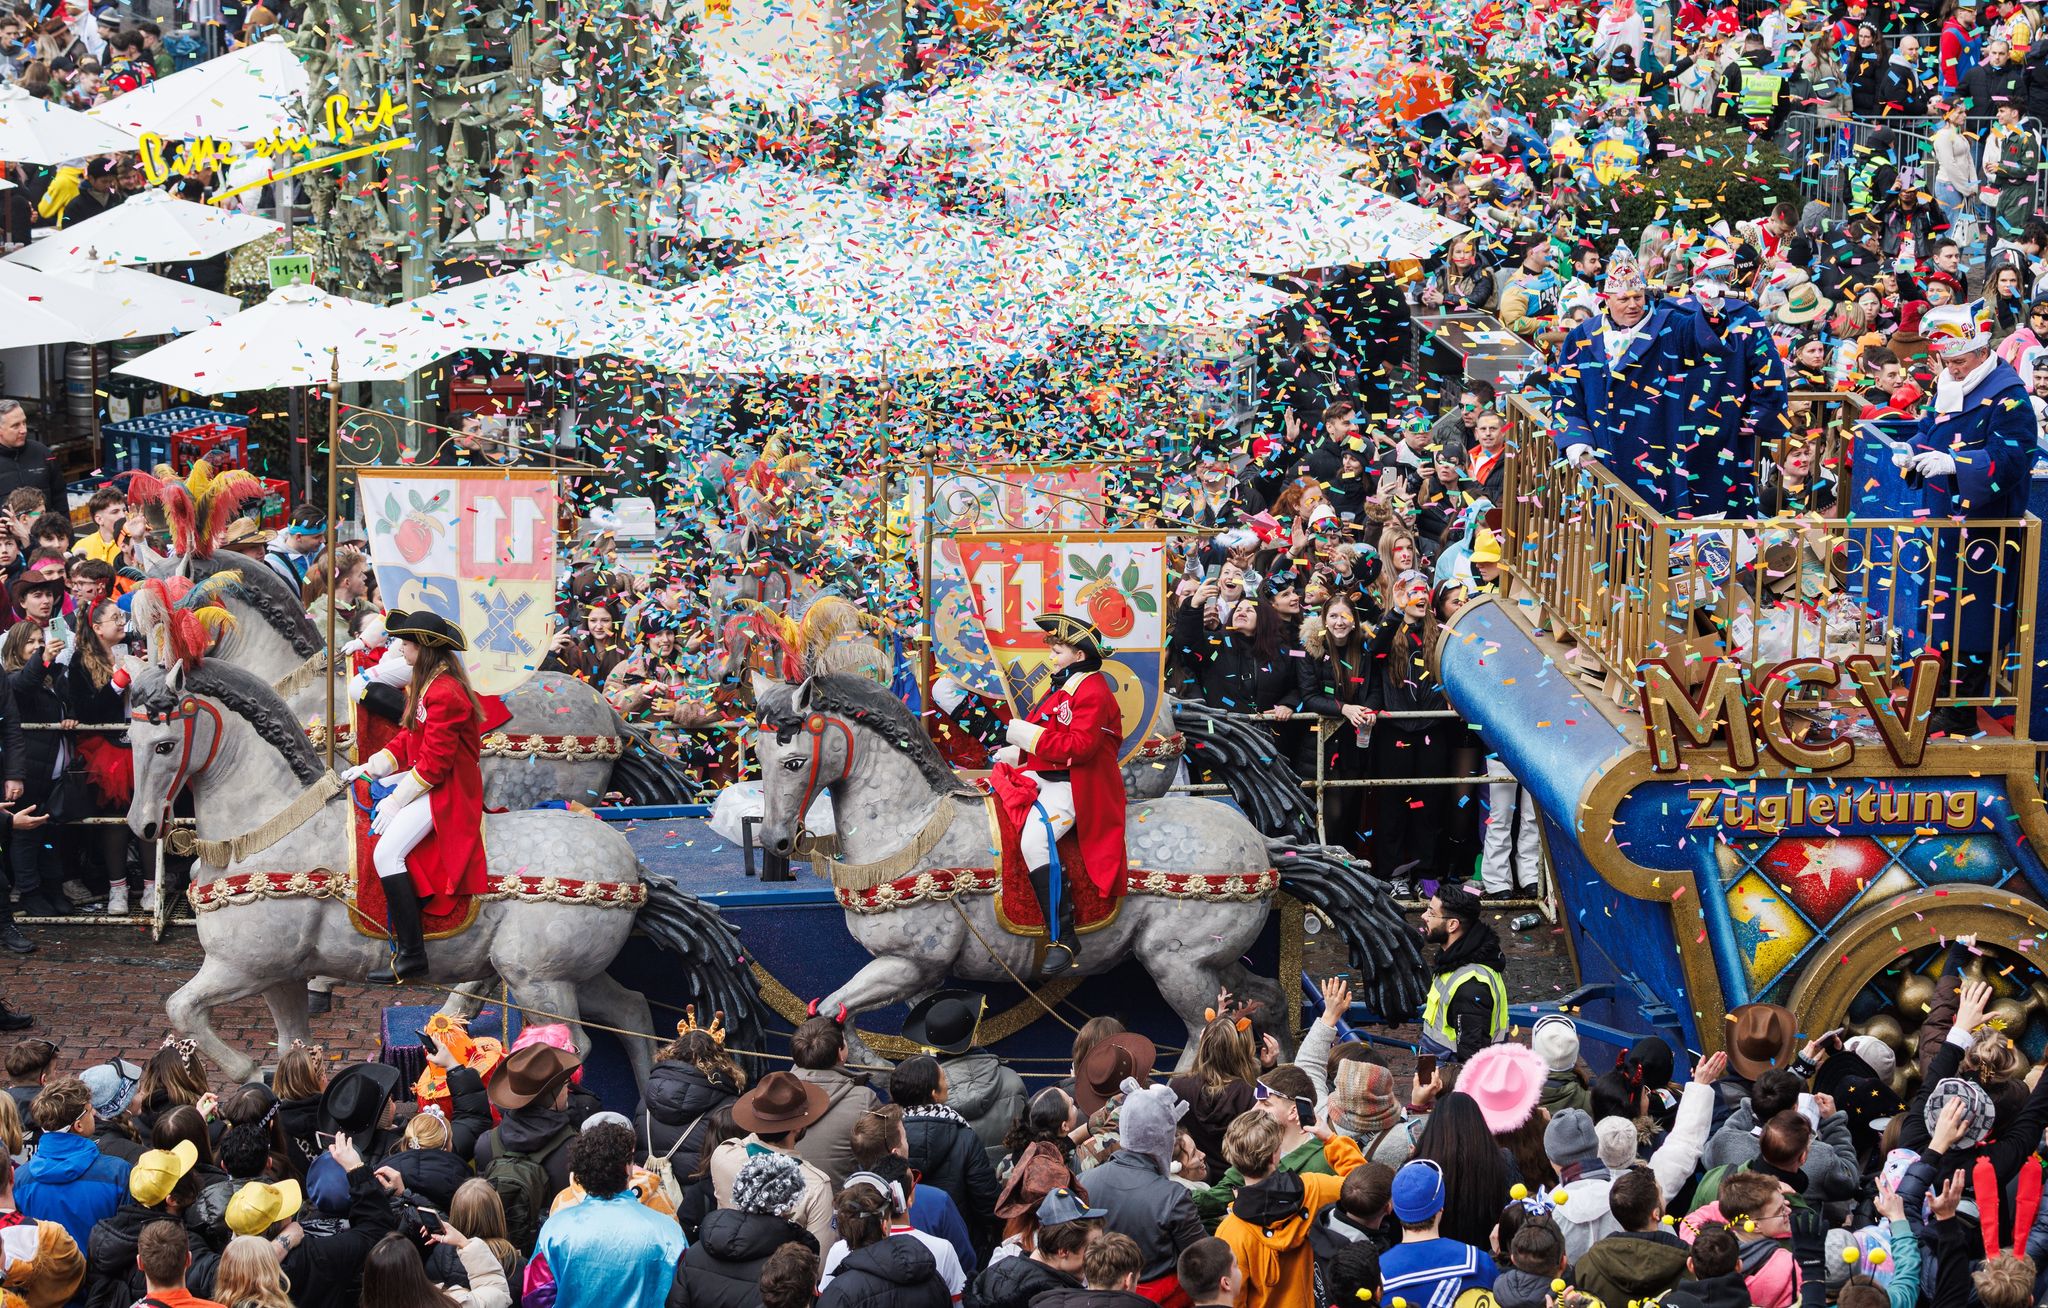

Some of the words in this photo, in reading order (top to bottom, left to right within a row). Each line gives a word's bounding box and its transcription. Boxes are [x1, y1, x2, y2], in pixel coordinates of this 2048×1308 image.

[139, 131, 239, 185] Bitte
[253, 127, 318, 158] ein
[325, 88, 409, 145] Bit
[274, 264, 308, 275] 11-11
[971, 561, 1043, 632] 11
[1637, 655, 1944, 773] MCV
[1687, 786, 1978, 835] Zugleitung
[259, 1101, 280, 1128] uvex
